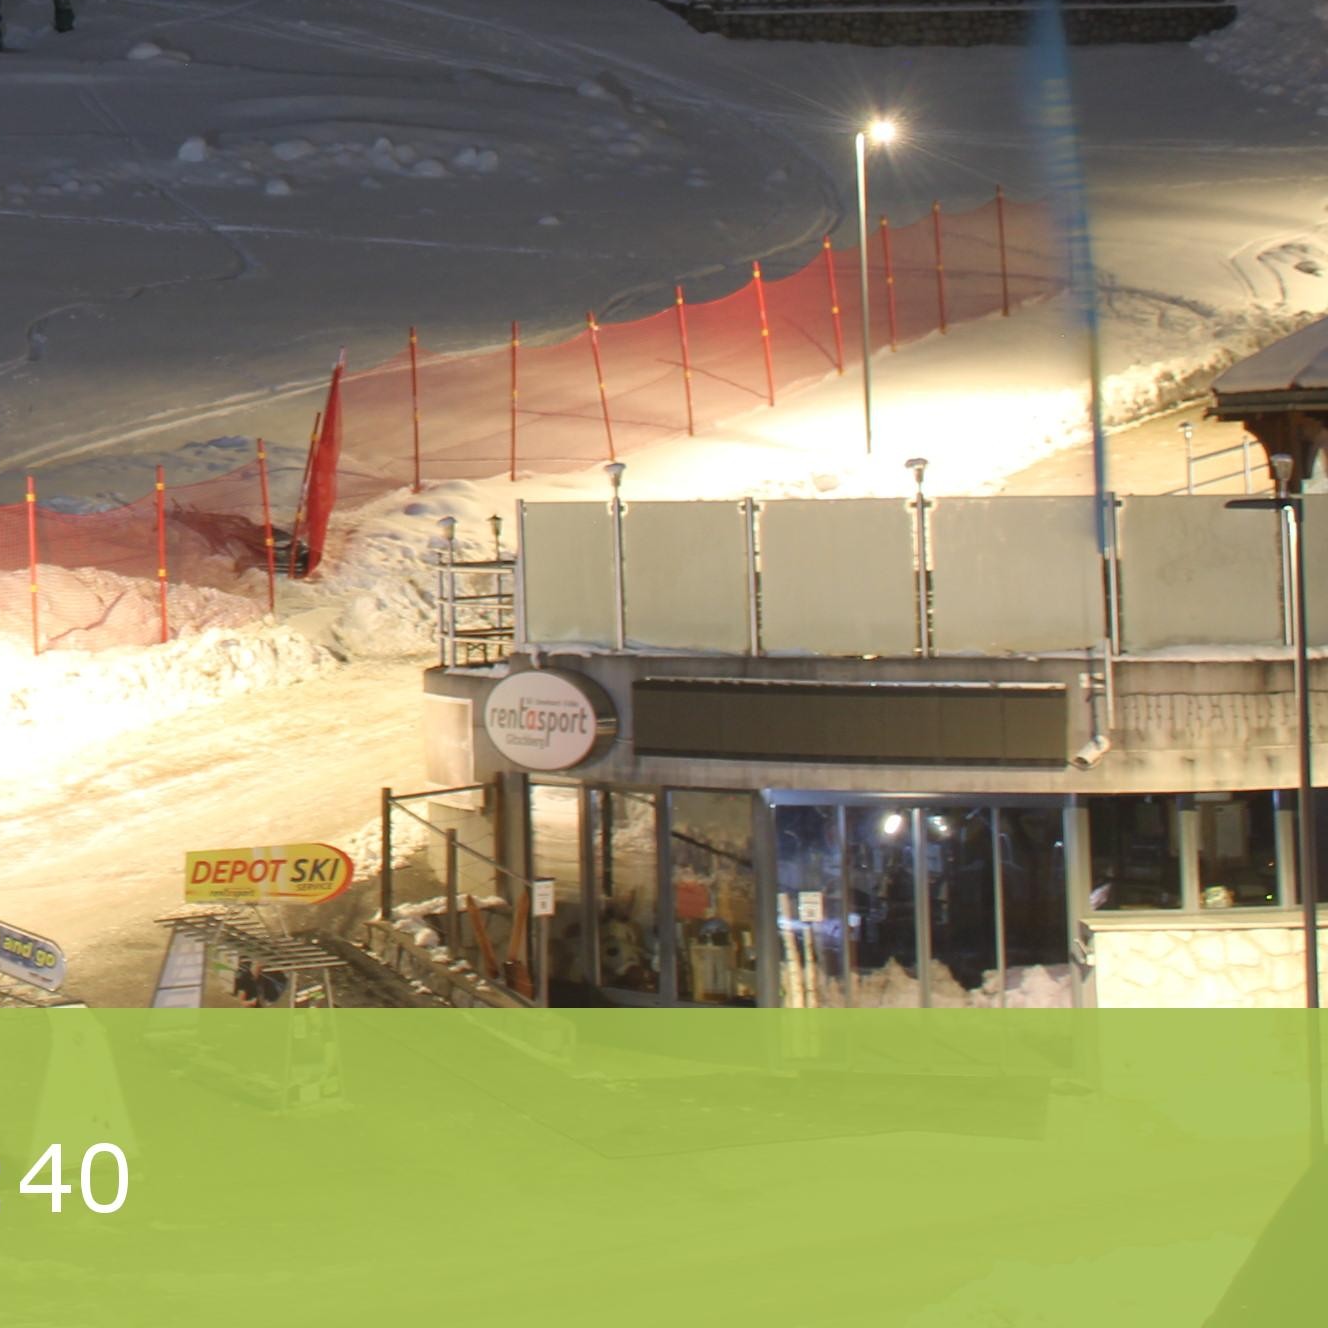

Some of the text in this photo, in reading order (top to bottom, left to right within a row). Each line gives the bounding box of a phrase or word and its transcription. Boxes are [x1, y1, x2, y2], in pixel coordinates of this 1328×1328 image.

[490, 697, 588, 747] rentasport
[191, 857, 341, 885] DEPOT SKI
[2, 936, 33, 960] and
[34, 949, 57, 969] go
